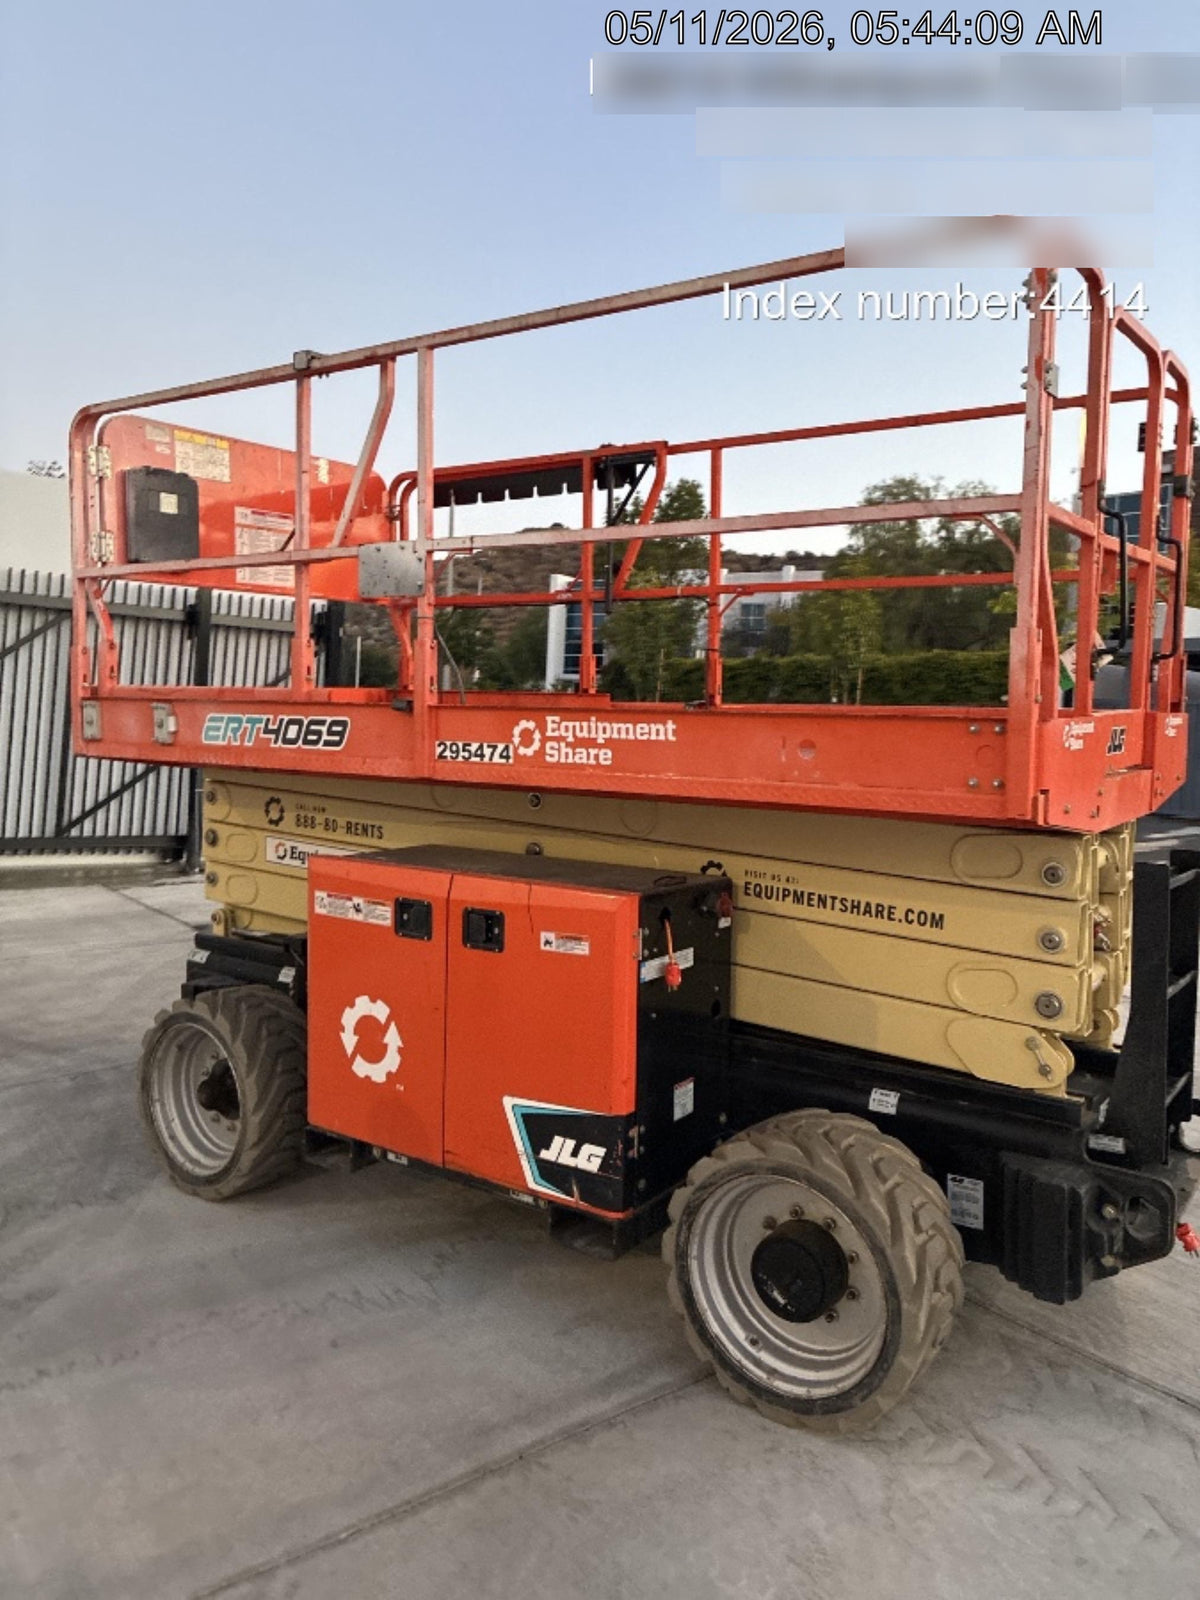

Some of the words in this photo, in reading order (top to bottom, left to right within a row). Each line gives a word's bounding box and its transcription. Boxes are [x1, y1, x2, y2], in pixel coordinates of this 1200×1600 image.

[202, 713, 350, 750] ERT4069
[545, 715, 677, 744] Equipment
[436, 740, 513, 764] 295474
[545, 741, 613, 766] Share
[743, 881, 946, 931] EQUIPMENTSHARE.COM
[538, 1135, 608, 1174] JLG
